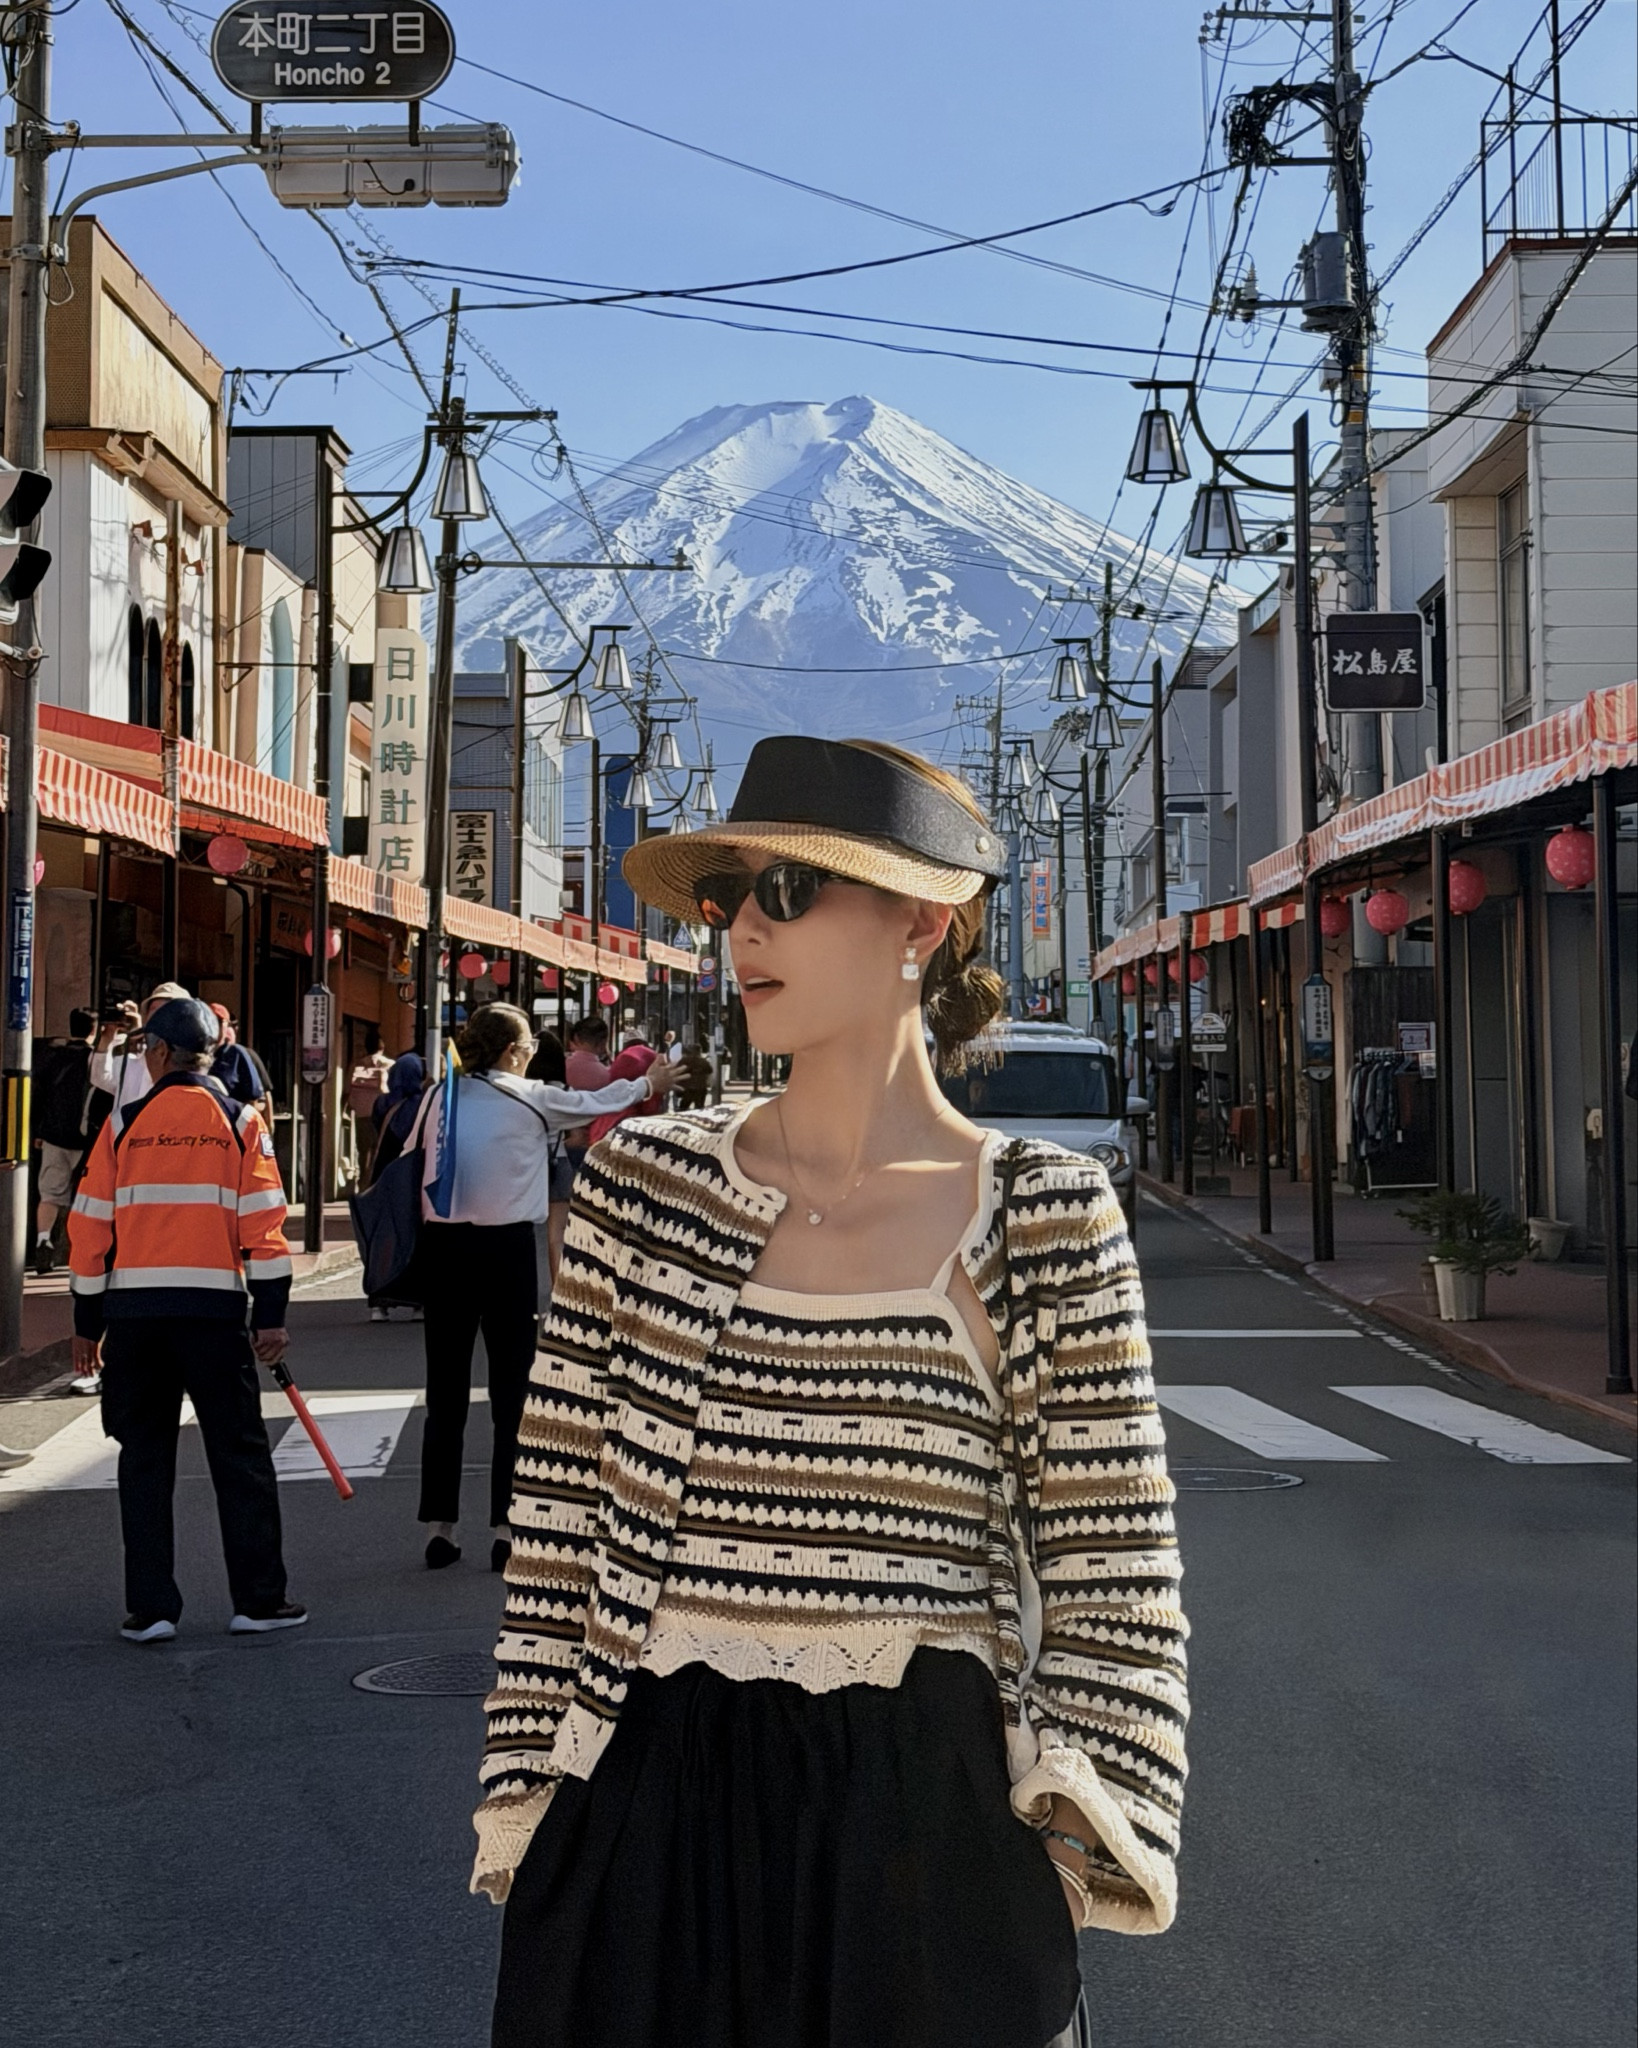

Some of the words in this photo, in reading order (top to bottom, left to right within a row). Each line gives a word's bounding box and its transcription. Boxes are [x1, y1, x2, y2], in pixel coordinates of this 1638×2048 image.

[238, 11, 425, 57] 本町二丁目
[274, 62, 365, 86] Honcho
[375, 61, 391, 85] 2
[1332, 647, 1418, 676] 松島屋
[377, 646, 417, 873] 日川時計店
